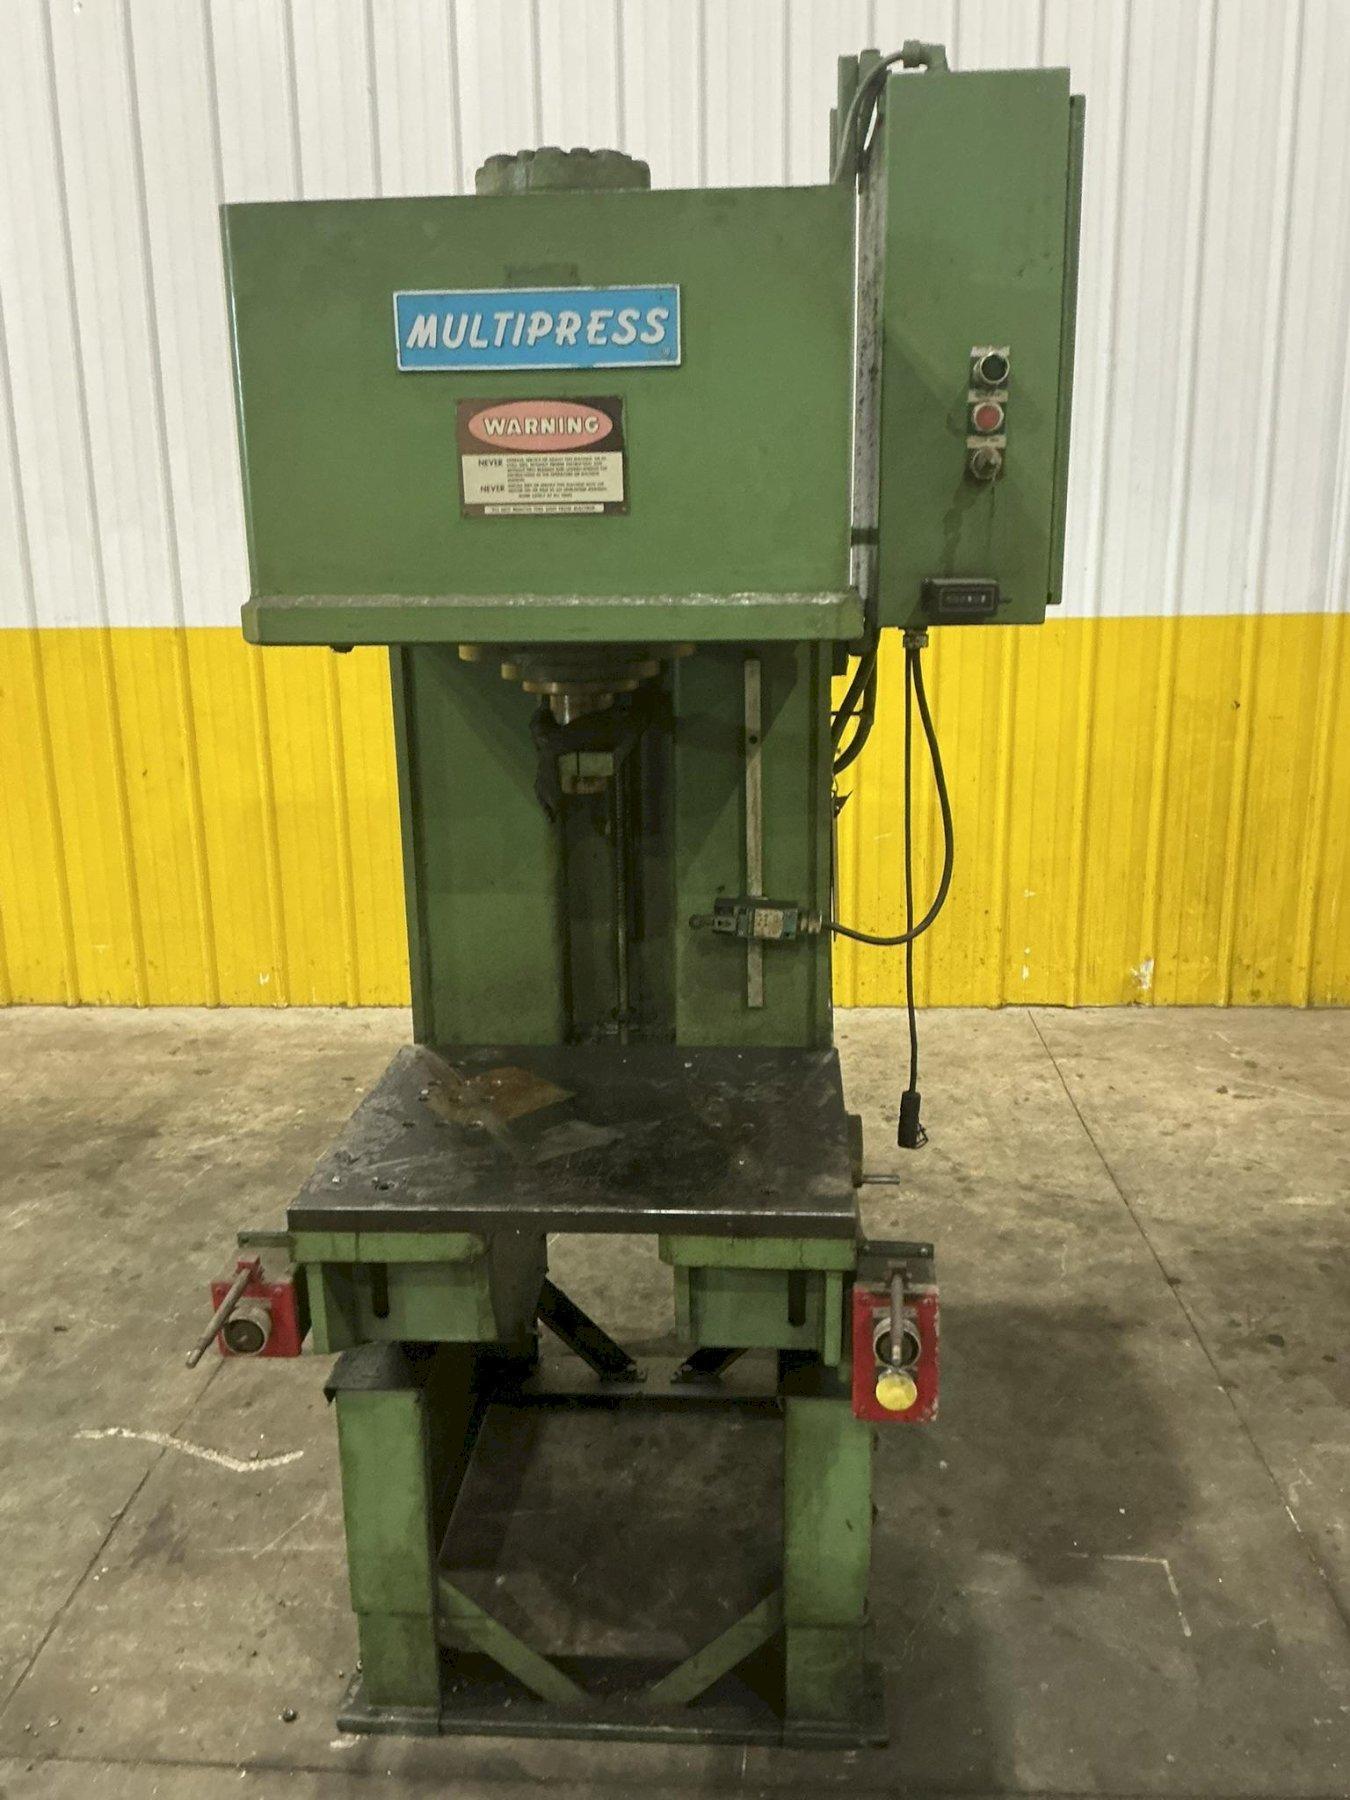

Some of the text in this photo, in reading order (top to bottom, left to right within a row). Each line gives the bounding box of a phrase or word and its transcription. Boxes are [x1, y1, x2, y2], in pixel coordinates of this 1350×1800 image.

[406, 307, 669, 349] MULTIPRESS
[484, 416, 599, 435] WARNING
[478, 458, 503, 467] NEVER
[480, 485, 505, 493] NEVER
